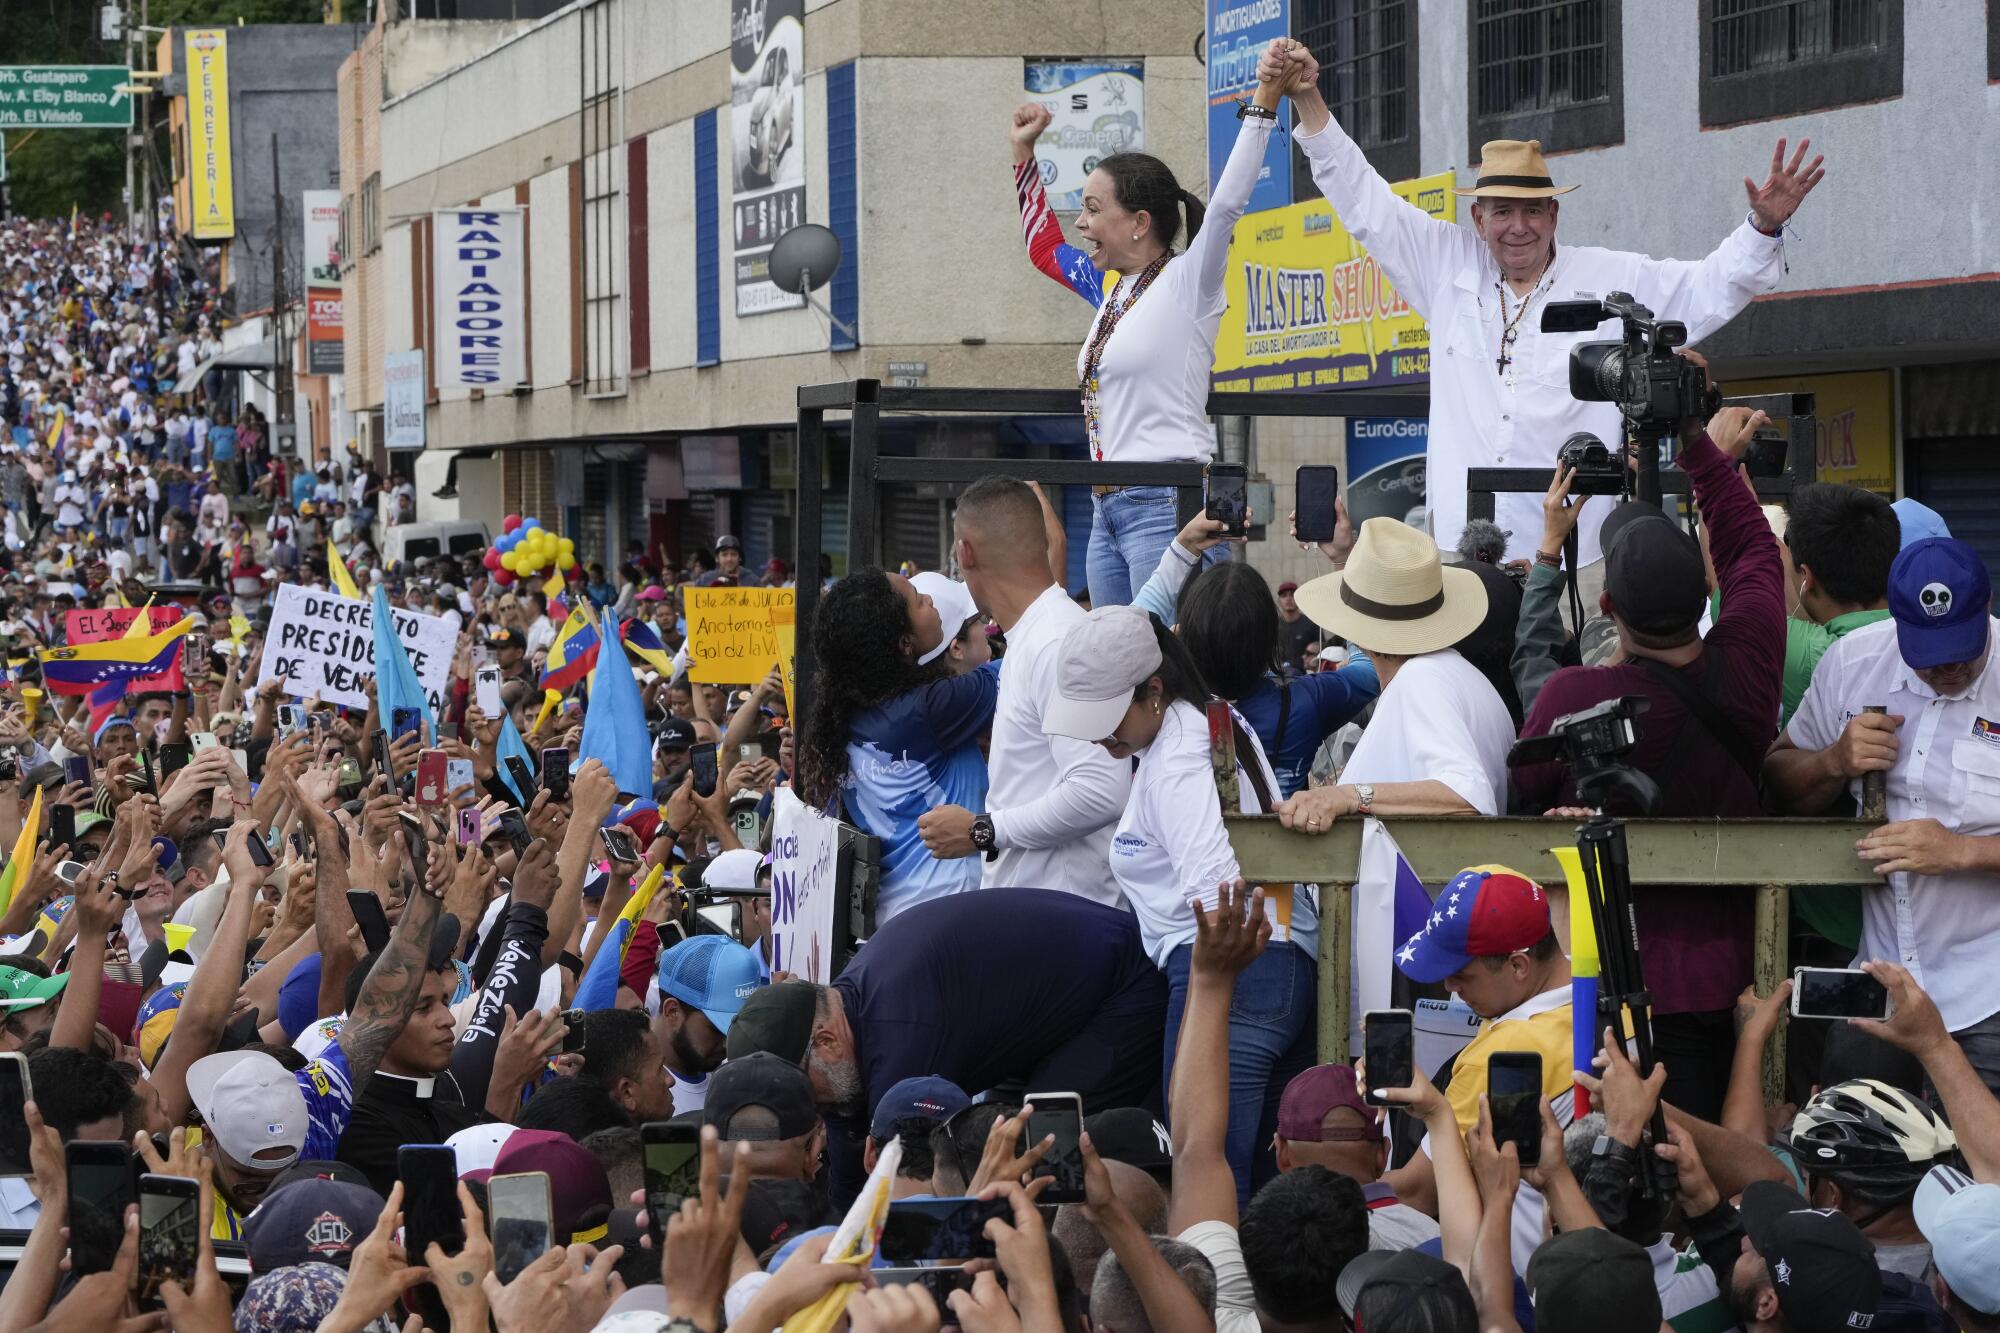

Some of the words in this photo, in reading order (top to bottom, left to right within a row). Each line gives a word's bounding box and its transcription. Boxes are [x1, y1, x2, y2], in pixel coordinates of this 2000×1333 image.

[1214, 0, 1281, 36] AMORTIGUADORES
[23, 70, 89, 86] Guataparo
[17, 90, 30, 103] A.
[33, 89, 61, 106] Eloy
[64, 90, 107, 103] Blanco
[24, 110, 37, 122] El
[40, 110, 83, 122] Viñedo
[201, 55, 220, 216] FERRETERIA
[456, 213, 503, 384] RADIADORES
[1245, 263, 1327, 333] MASTER
[1246, 341, 1254, 356] LA
[1255, 338, 1269, 355] CASA
[1271, 337, 1281, 354] DEL
[1282, 330, 1328, 352] AMORTIGUADOR
[79, 615, 98, 634] EL
[695, 640, 720, 659] Gol
[772, 830, 799, 864] ncia
